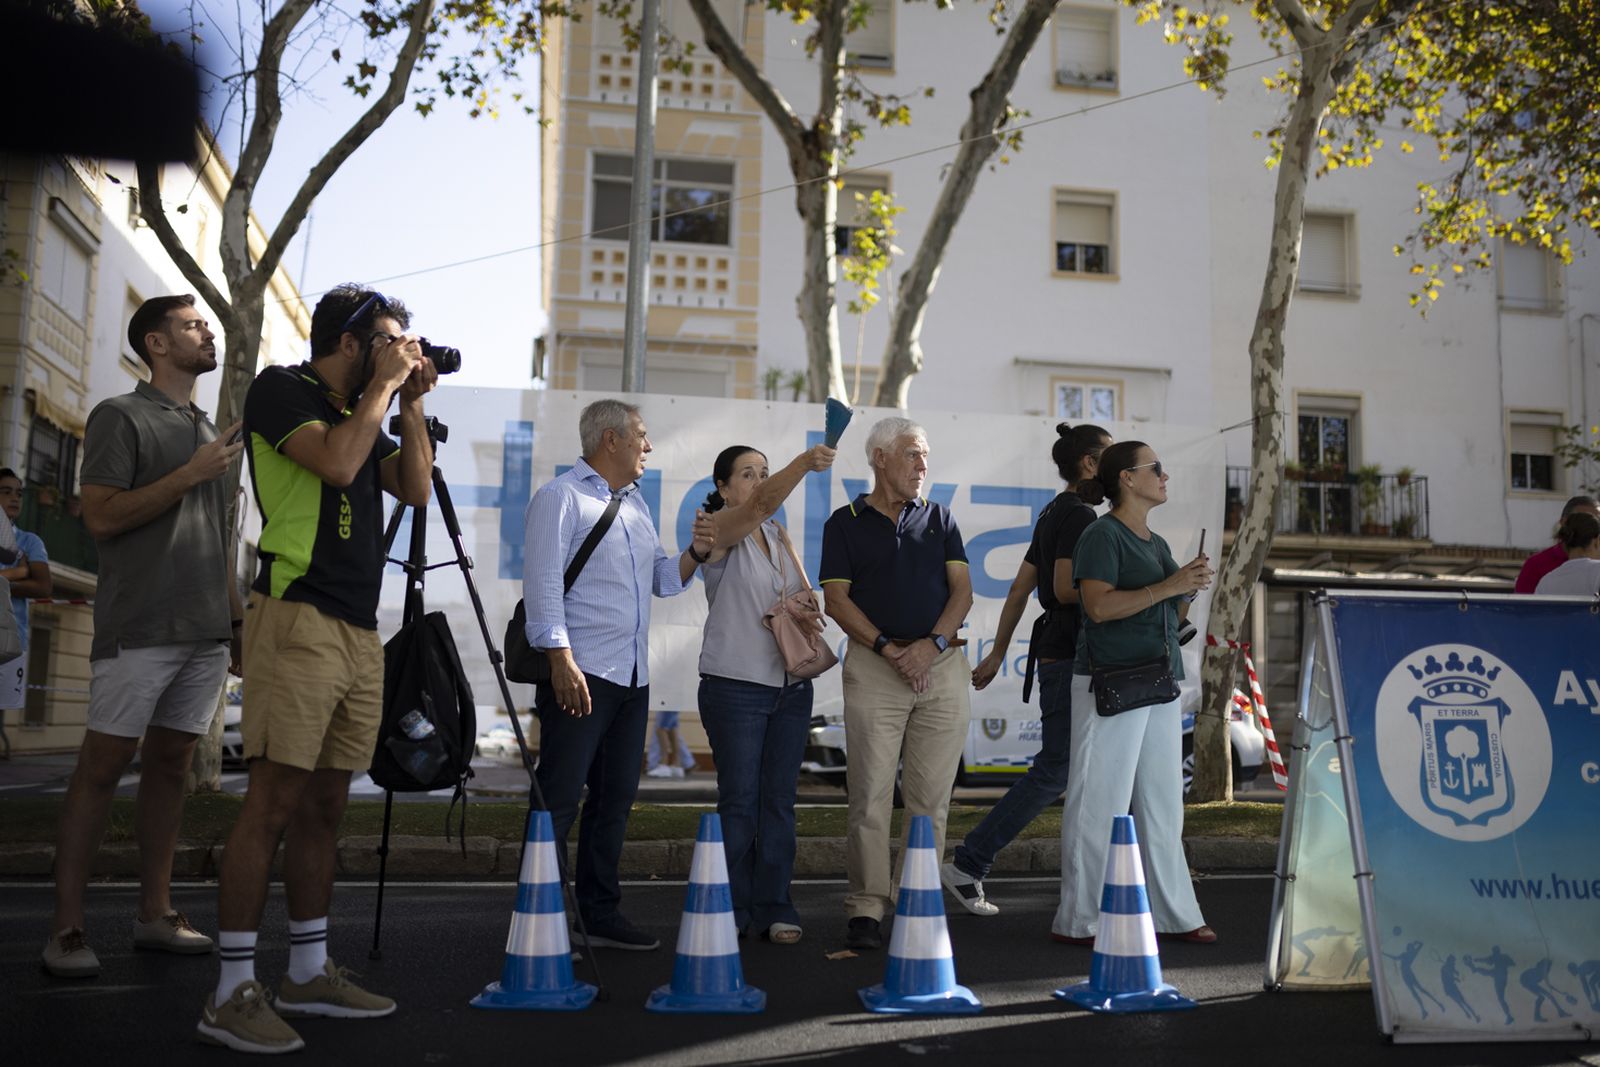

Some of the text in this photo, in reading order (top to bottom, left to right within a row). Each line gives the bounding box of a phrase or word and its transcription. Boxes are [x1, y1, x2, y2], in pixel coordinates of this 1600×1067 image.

[384, 420, 1057, 600] Hla
[1437, 709, 1480, 717] ET TERRA
[1424, 722, 1438, 789] PORTUS MARIS
[1490, 733, 1502, 778] CUSTODIA
